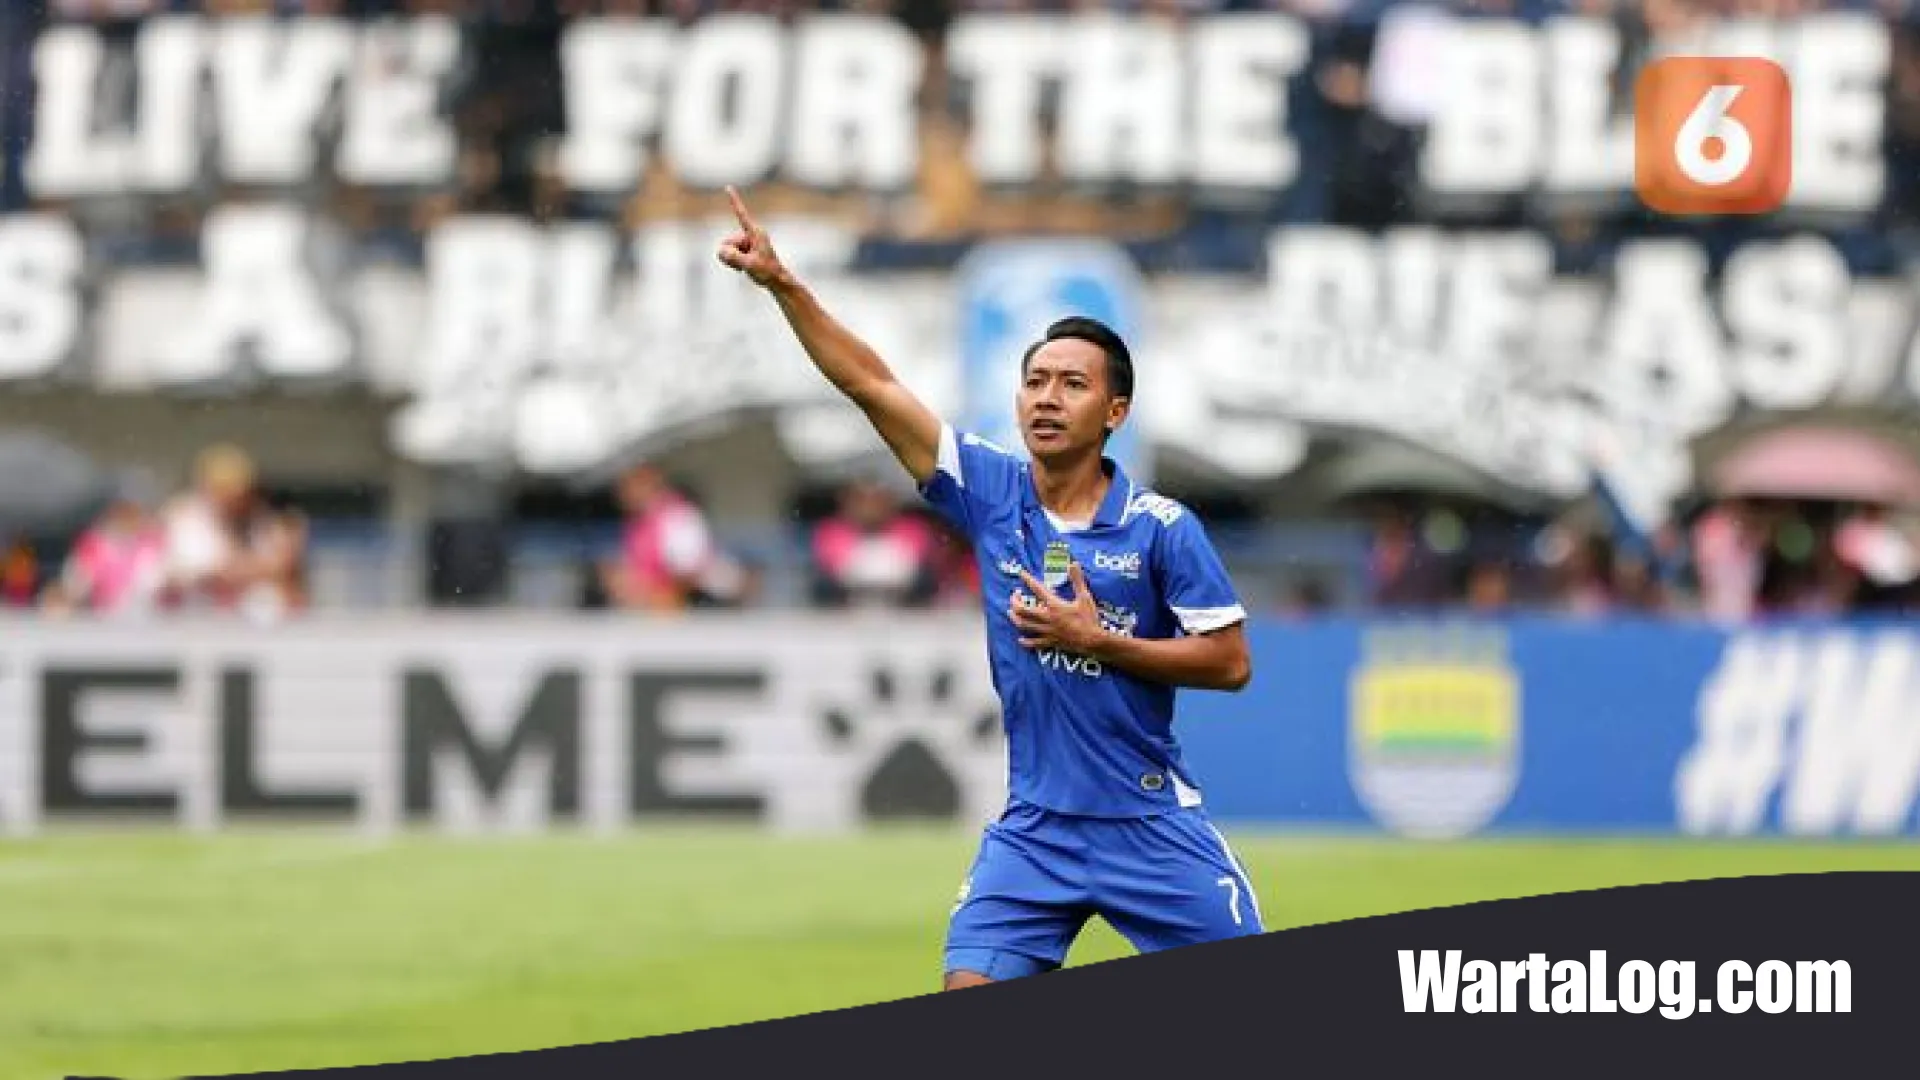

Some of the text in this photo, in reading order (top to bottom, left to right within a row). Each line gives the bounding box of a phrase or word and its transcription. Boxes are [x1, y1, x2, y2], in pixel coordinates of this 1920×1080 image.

[26, 12, 1892, 212] LIVE FOR THE BLE
[1037, 650, 1102, 679] vivo
[0, 664, 770, 817] ELME
[1217, 876, 1242, 926] 7
